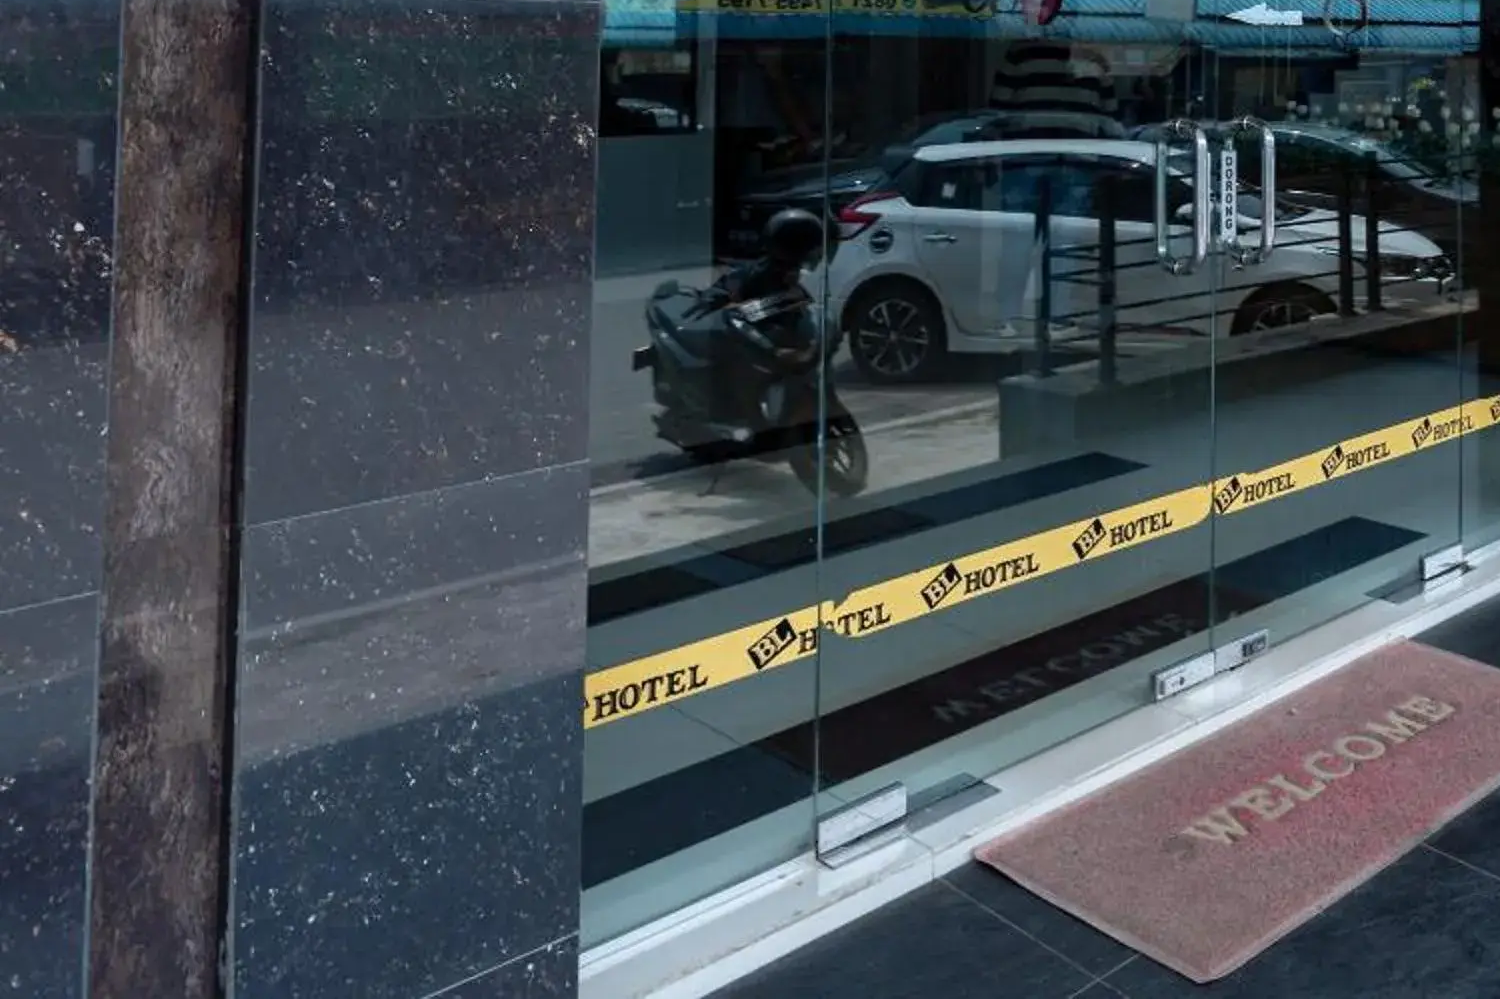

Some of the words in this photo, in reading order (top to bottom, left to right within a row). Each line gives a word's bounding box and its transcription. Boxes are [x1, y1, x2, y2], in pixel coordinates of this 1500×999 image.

[1225, 156, 1233, 230] DORONG
[591, 665, 709, 721] HOTEL
[750, 622, 795, 667] BL
[797, 603, 891, 655] HTEL
[922, 566, 961, 608] BL
[963, 553, 1040, 595] HOTEL
[1108, 510, 1173, 548] HOTEL
[1243, 473, 1296, 503] HOTEL
[1345, 442, 1391, 470] HOTEL
[1433, 415, 1475, 441] HOTEL
[1182, 694, 1456, 846] WELCOME
